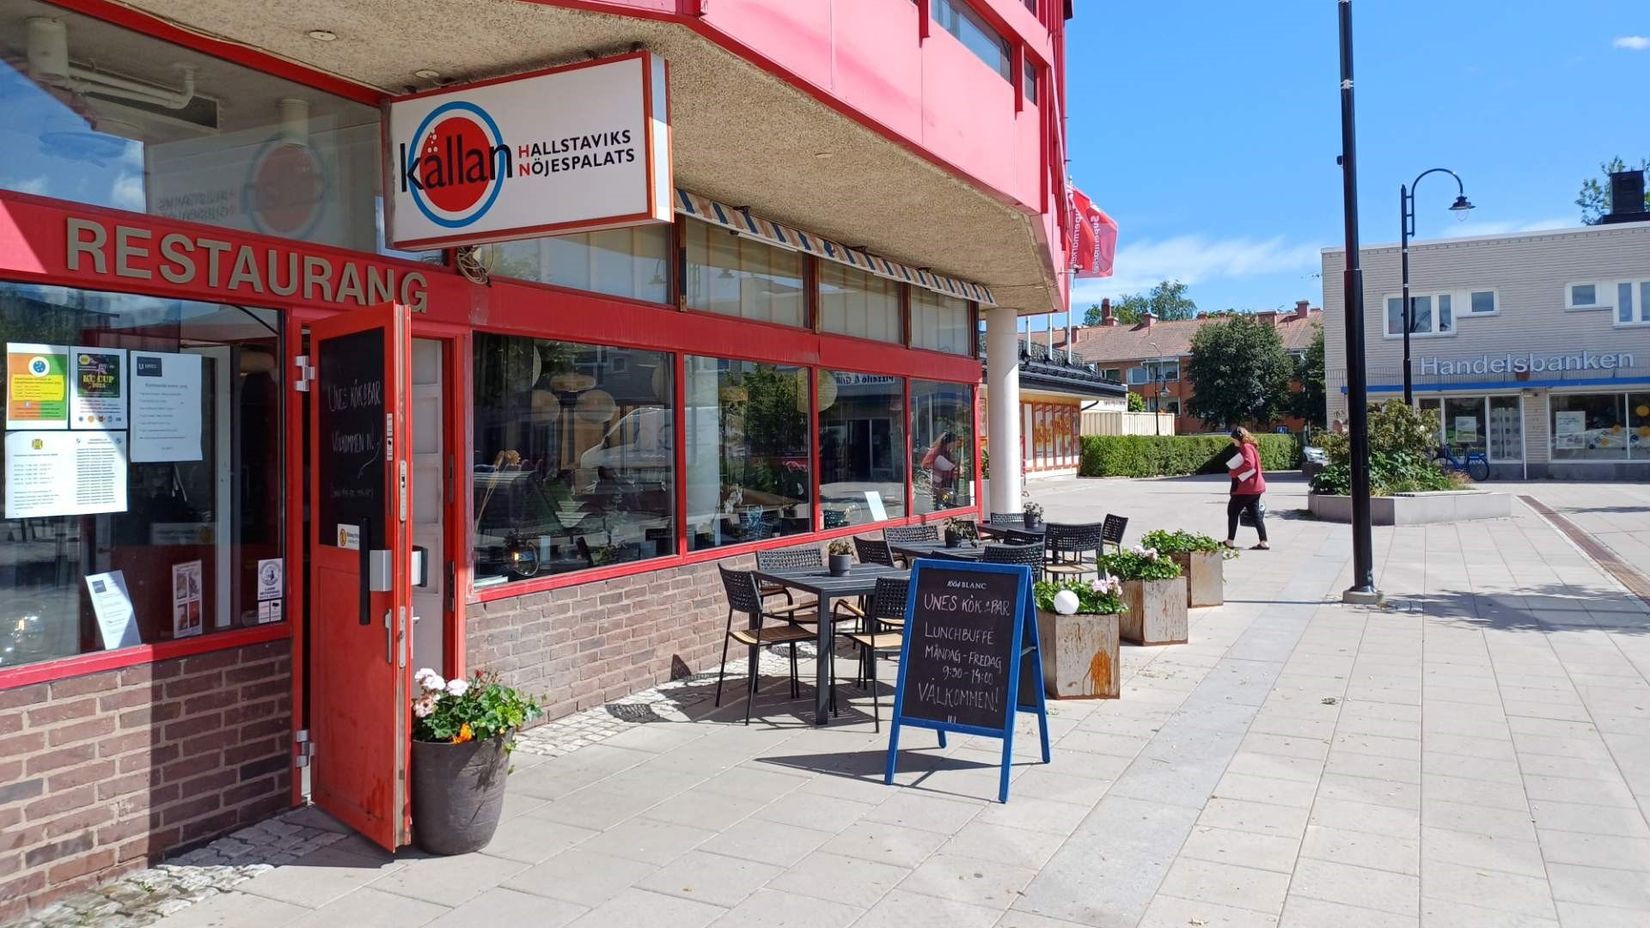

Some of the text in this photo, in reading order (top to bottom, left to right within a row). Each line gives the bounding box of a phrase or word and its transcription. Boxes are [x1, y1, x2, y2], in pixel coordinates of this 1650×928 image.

[518, 129, 632, 159] HALLSTAVIKS
[518, 148, 635, 178] NÖJESPALATS
[66, 217, 429, 313] RESTAURANG
[1420, 350, 1634, 376] Handelsbanken
[97, 374, 114, 383] CUP
[961, 581, 987, 590] BLANC
[924, 593, 958, 612] UNES
